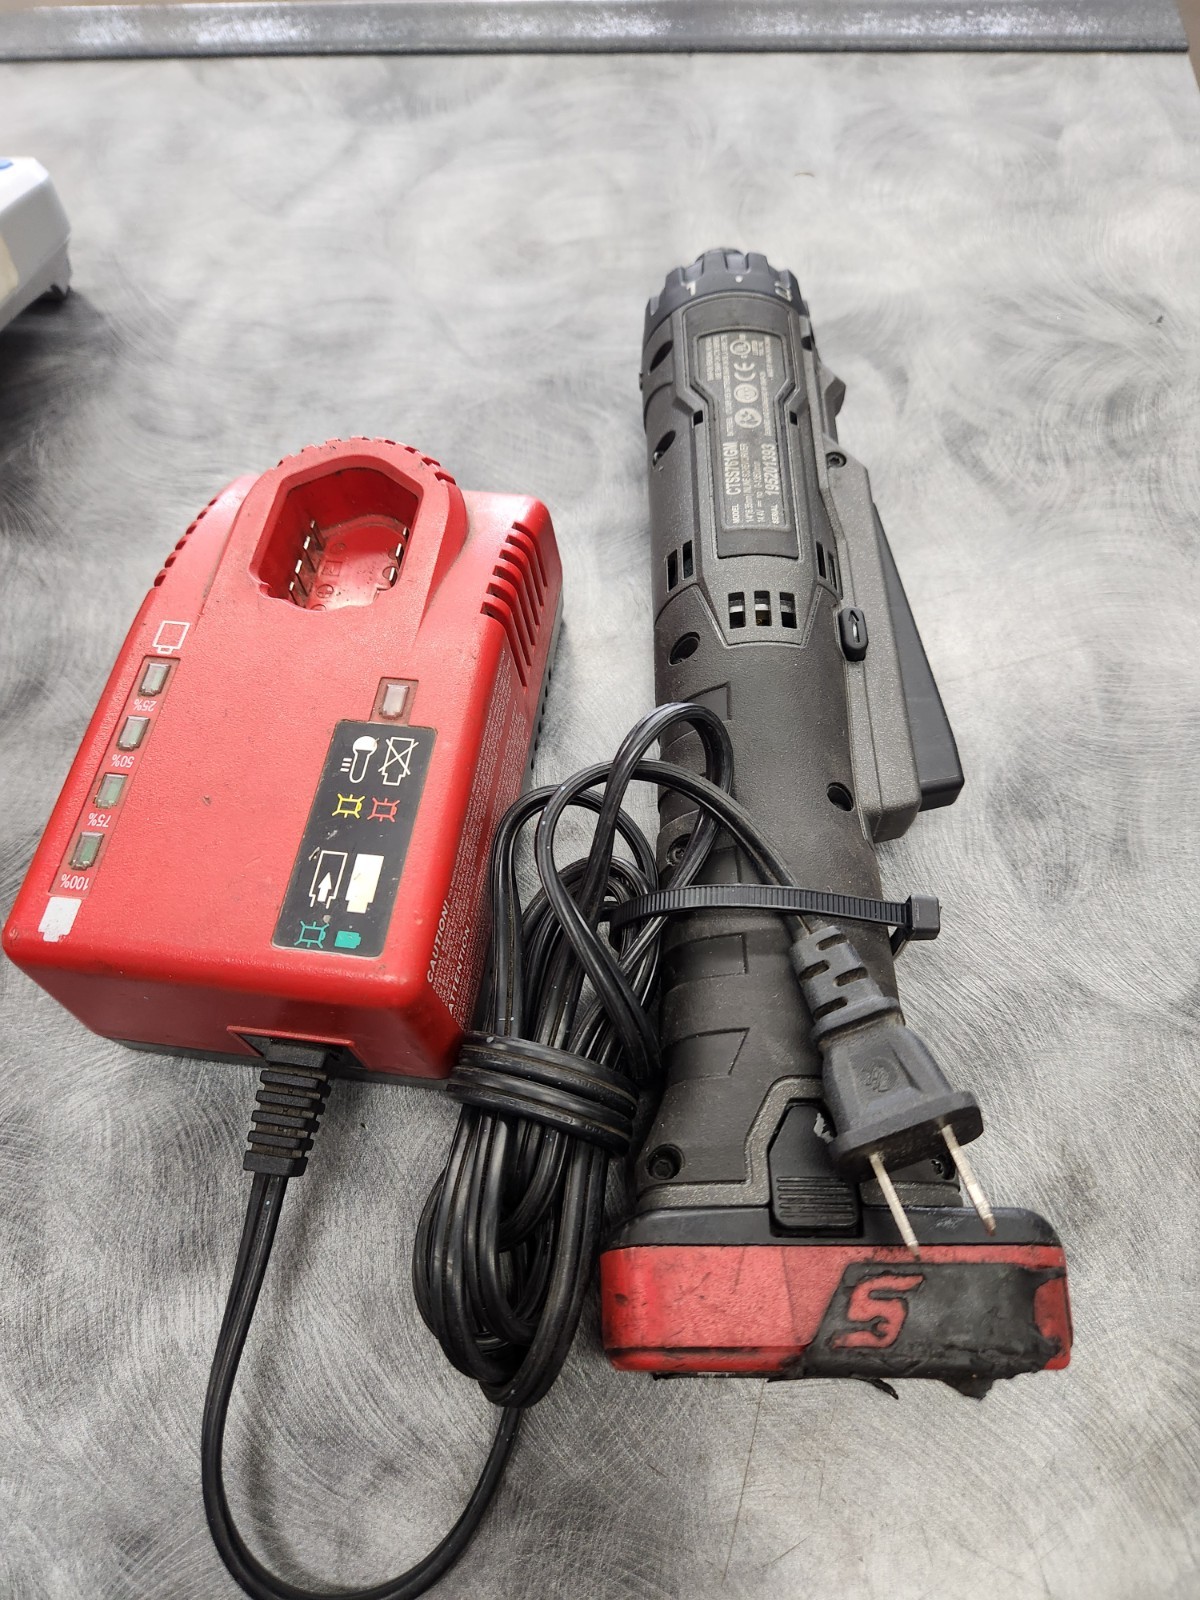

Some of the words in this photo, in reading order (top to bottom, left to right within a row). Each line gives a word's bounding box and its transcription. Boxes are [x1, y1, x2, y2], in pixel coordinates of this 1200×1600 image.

[723, 441, 742, 495] CTSS761GM
[761, 443, 780, 495] 195201393
[731, 502, 740, 524] MODEL
[771, 503, 780, 524] SERIAL
[133, 698, 157, 712] 25%
[111, 753, 135, 768] 50%
[87, 812, 112, 828] 75%
[60, 873, 90, 891] 100%
[427, 900, 449, 982] CAUTION!
[449, 925, 470, 1015] ATTENTION
